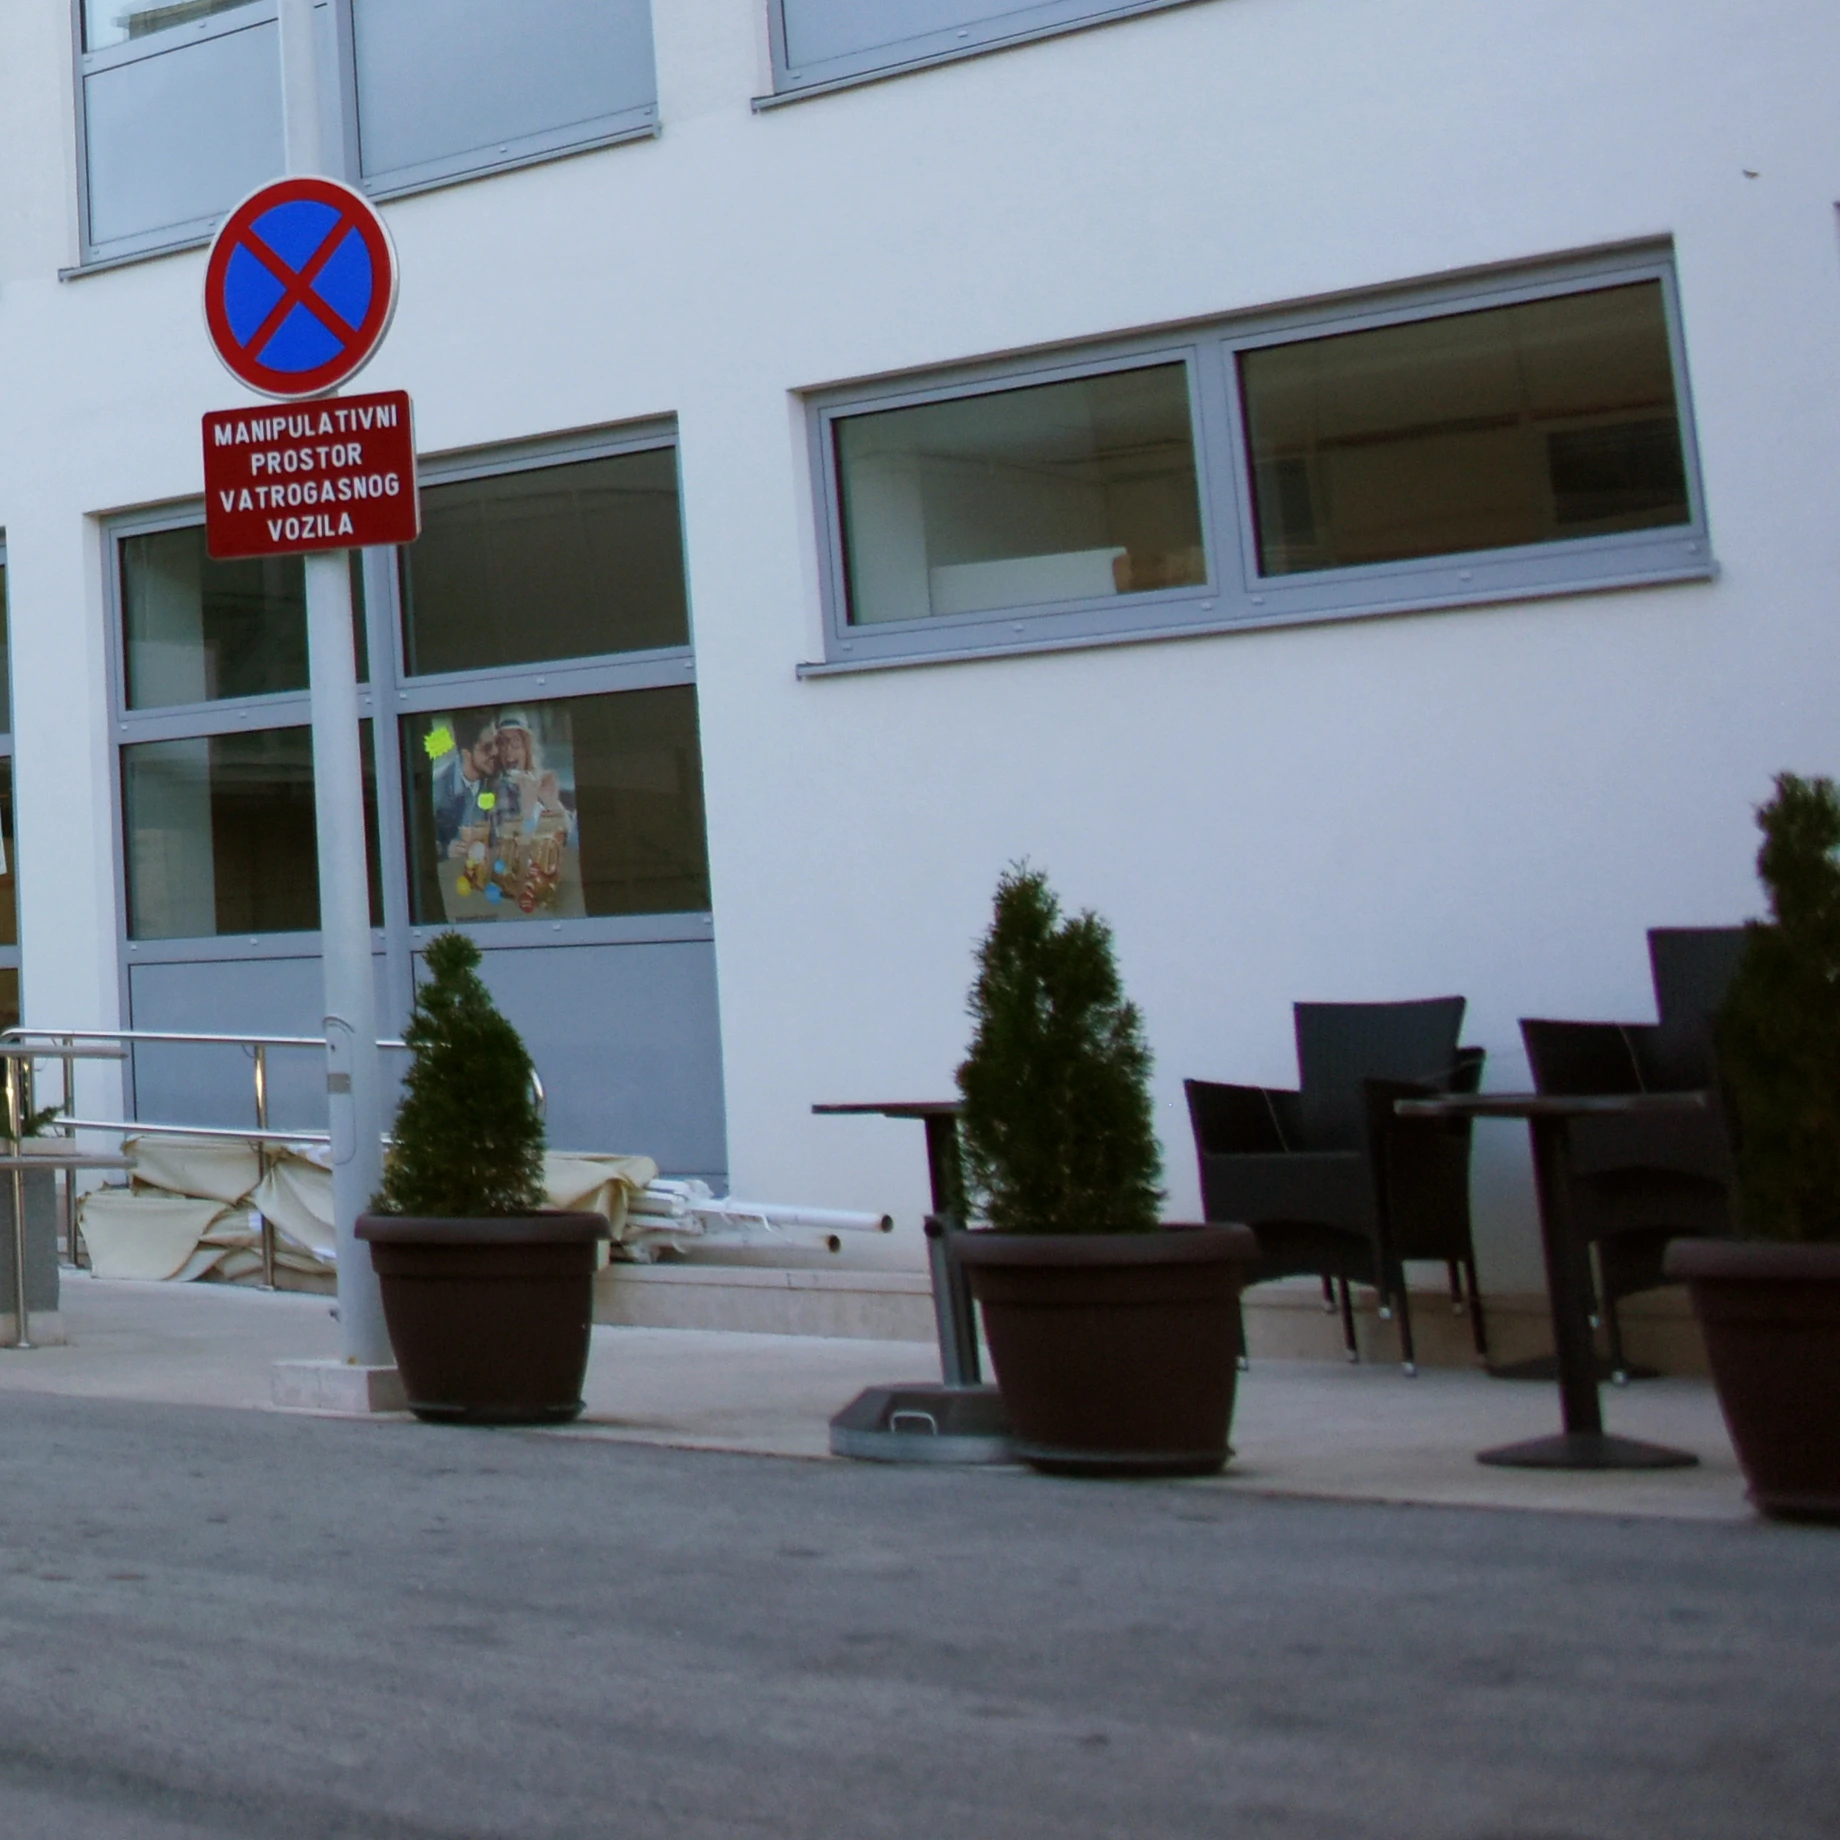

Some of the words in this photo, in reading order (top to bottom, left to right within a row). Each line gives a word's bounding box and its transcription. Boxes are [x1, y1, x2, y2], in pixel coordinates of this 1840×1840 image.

[214, 404, 397, 446] MANIPULATIVNI
[251, 443, 362, 476] PROSTOR
[220, 472, 400, 512] VATROGASNOG
[267, 512, 354, 542] VOZILA
